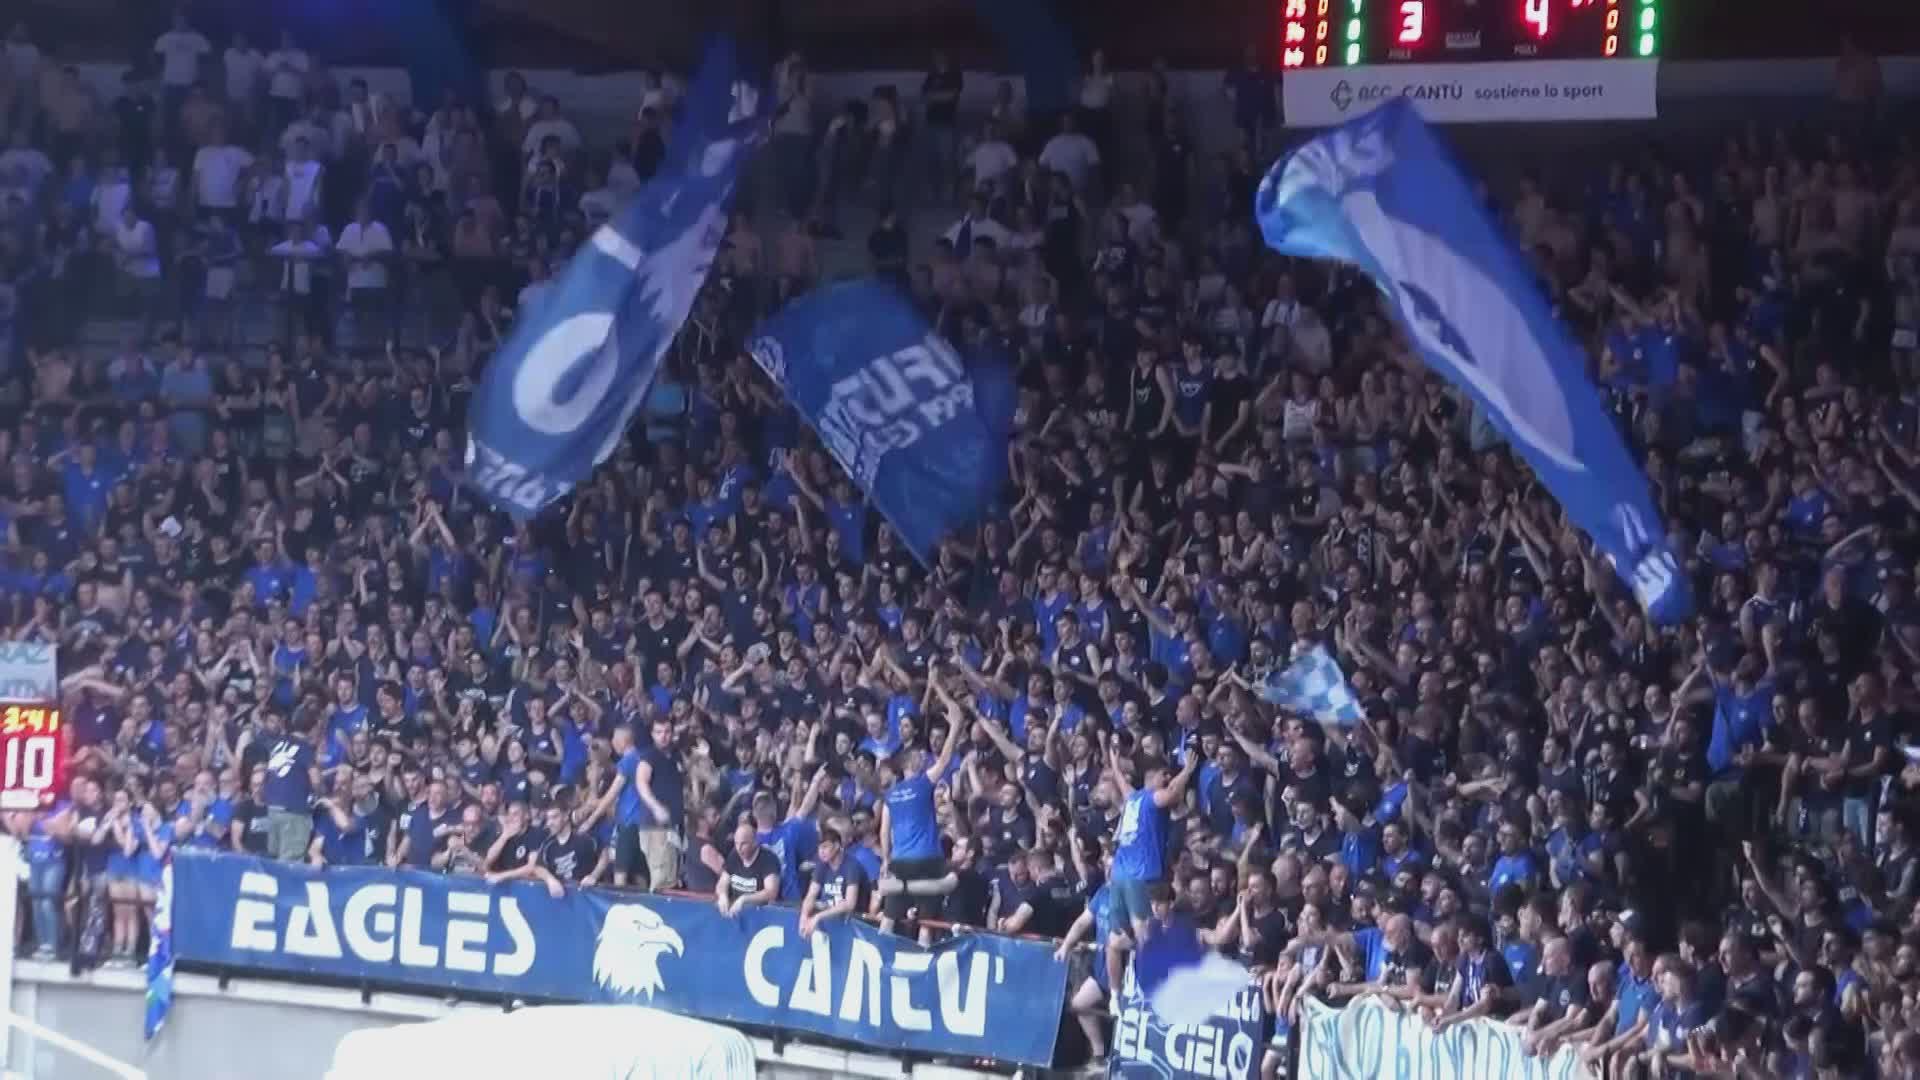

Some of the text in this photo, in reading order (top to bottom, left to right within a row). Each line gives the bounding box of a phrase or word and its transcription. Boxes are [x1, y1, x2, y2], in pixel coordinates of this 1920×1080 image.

[1399, 1, 1423, 42] 3
[1525, 0, 1549, 36] 4
[1474, 83, 1540, 100] sostiene
[1544, 83, 1559, 97] lo
[1562, 84, 1604, 100] sport
[5, 736, 55, 790] 10
[231, 871, 537, 976] EAGLES
[744, 925, 1004, 1037] CANTU'
[1165, 1022, 1253, 1080] CIELO
